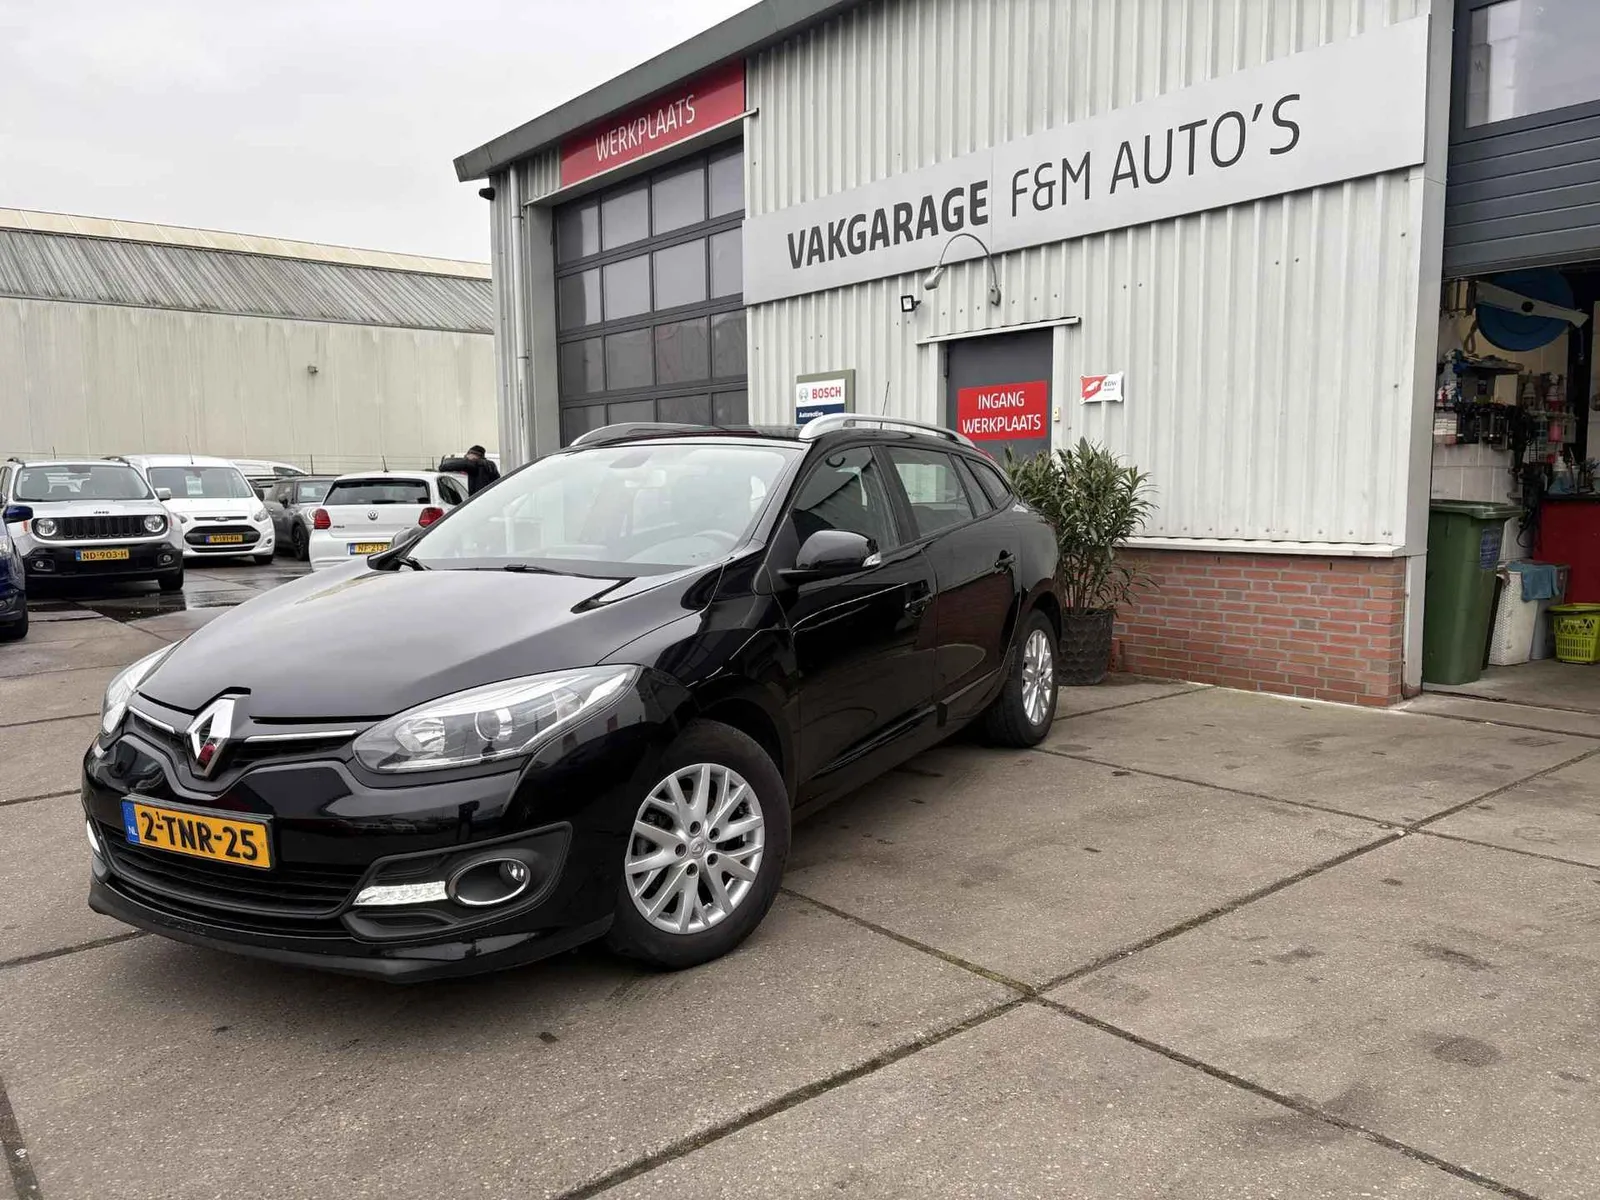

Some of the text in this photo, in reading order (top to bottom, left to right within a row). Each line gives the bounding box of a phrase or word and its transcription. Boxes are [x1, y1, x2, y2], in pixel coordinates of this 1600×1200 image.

[595, 94, 697, 162] WERKPLAATS
[787, 93, 1300, 270] VAKGARAGE F&M AUTO'S
[812, 386, 842, 399] BOSCH
[978, 390, 1025, 410] INGANG
[962, 414, 1041, 434] WERKPLAATS
[82, 550, 128, 560] ND-903-H
[128, 825, 138, 836] NL
